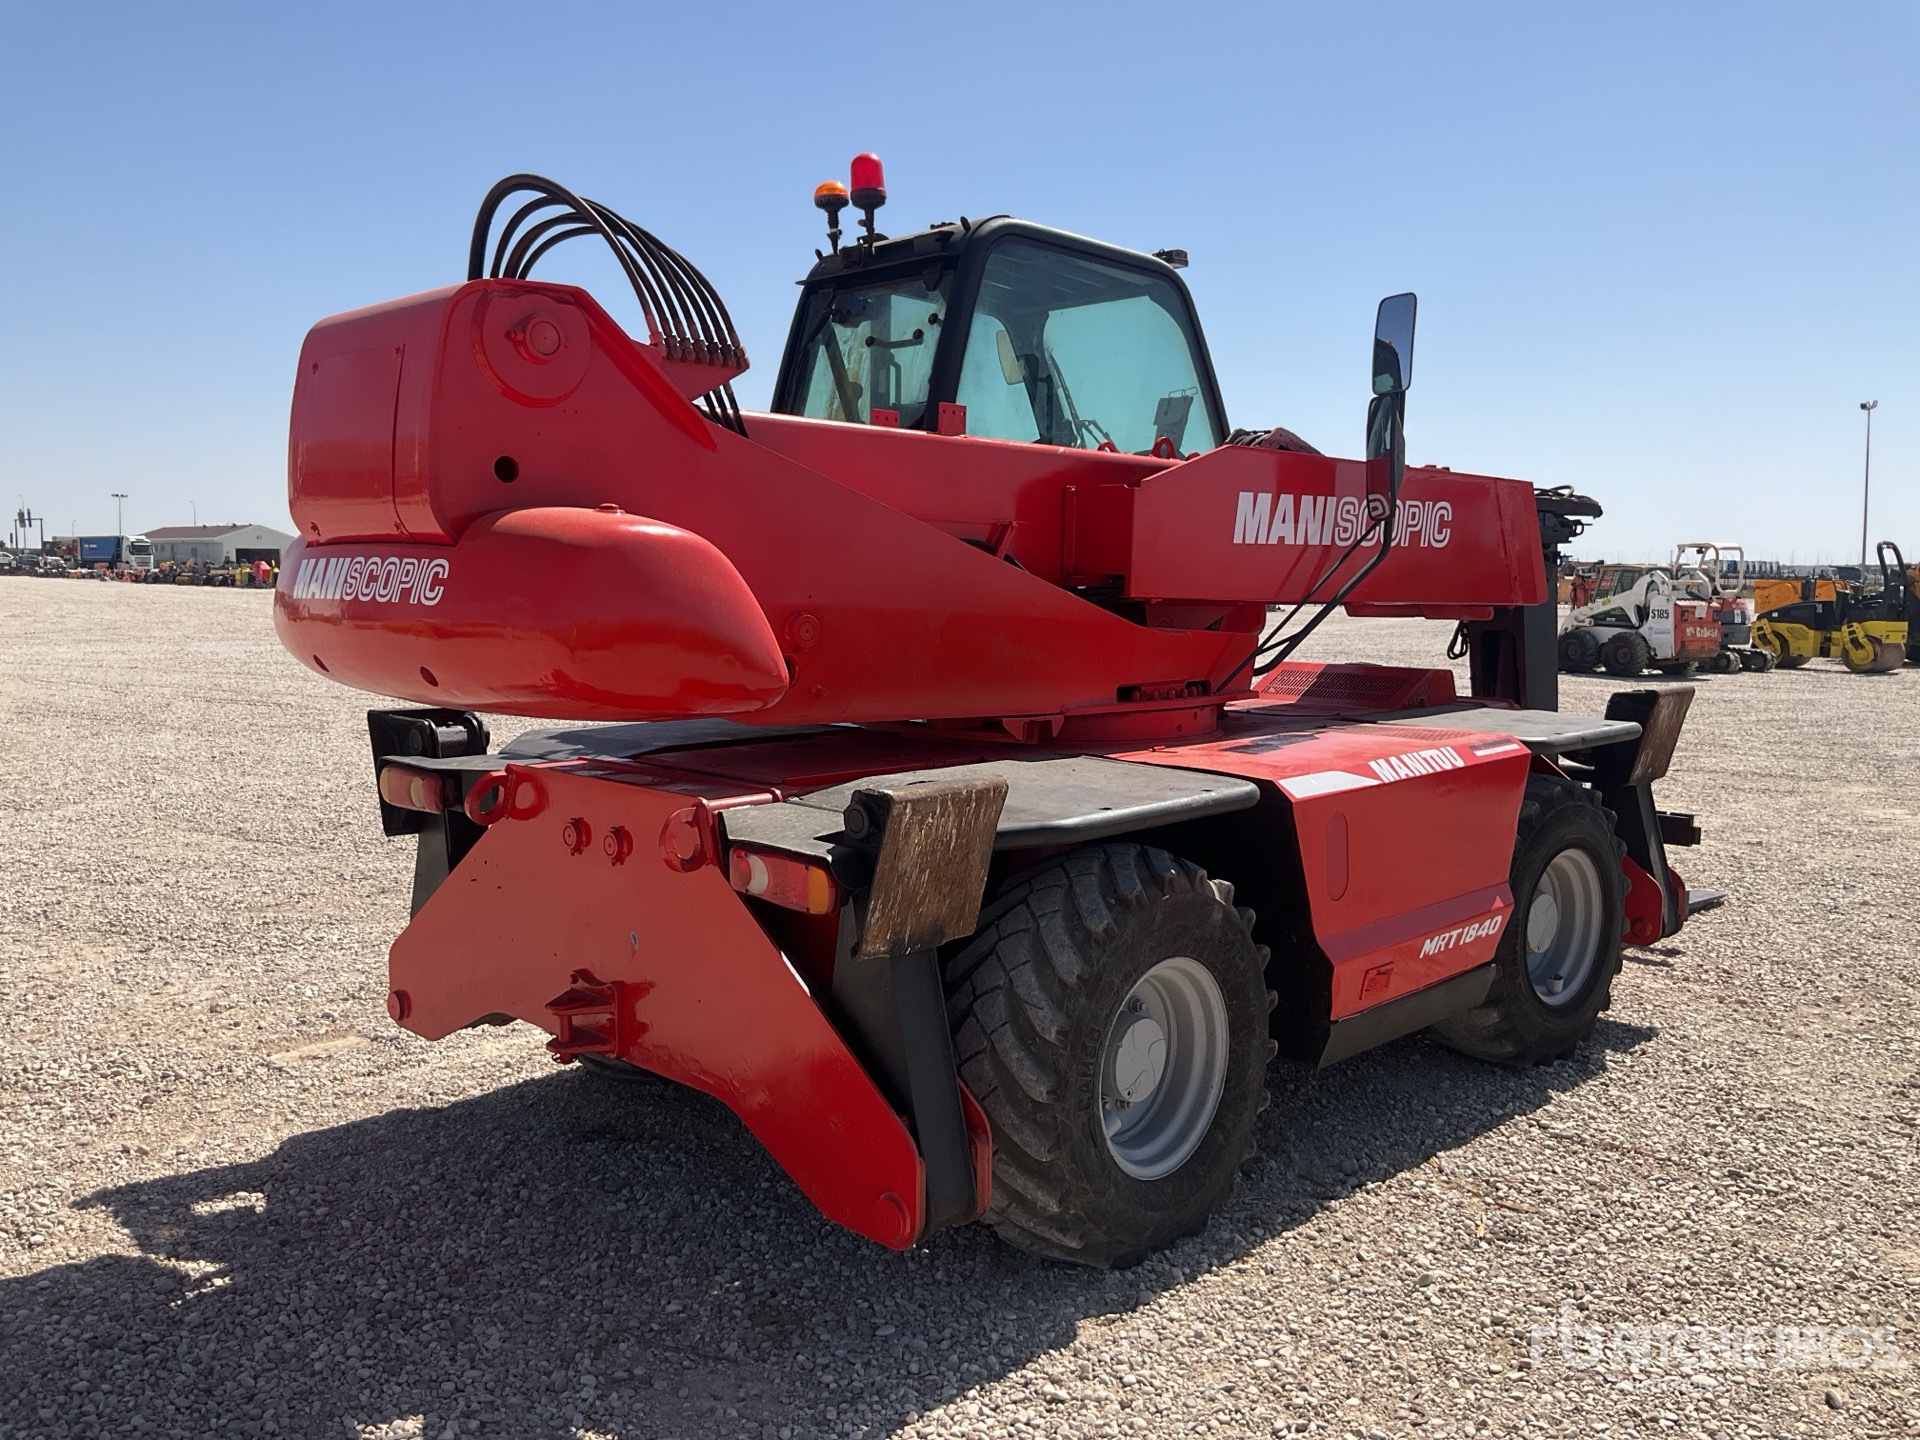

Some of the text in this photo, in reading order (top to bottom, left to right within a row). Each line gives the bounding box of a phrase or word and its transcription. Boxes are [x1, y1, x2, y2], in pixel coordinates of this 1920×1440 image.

[293, 556, 450, 606] MANISCOPIC
[1651, 608, 1670, 619] S185
[1368, 746, 1465, 783] MANITOU
